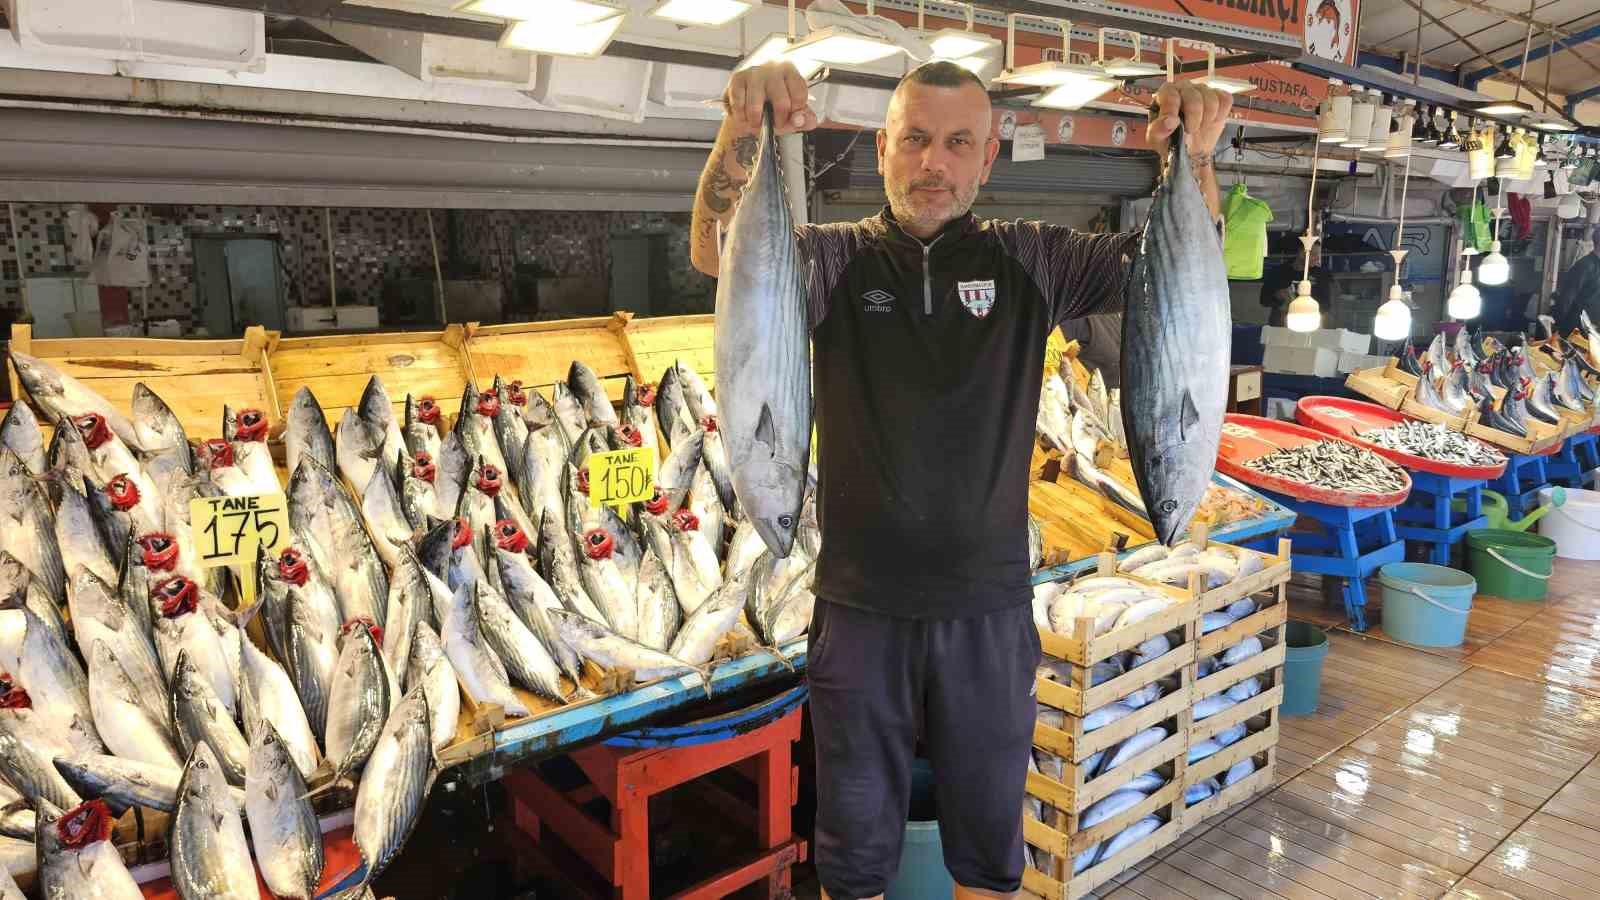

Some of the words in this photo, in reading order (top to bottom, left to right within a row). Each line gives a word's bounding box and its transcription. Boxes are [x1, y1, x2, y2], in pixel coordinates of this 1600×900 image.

[1248, 76, 1308, 97] MUSTAFA
[605, 452, 640, 465] TANE
[208, 496, 260, 512] TANE
[203, 508, 280, 560] 175
